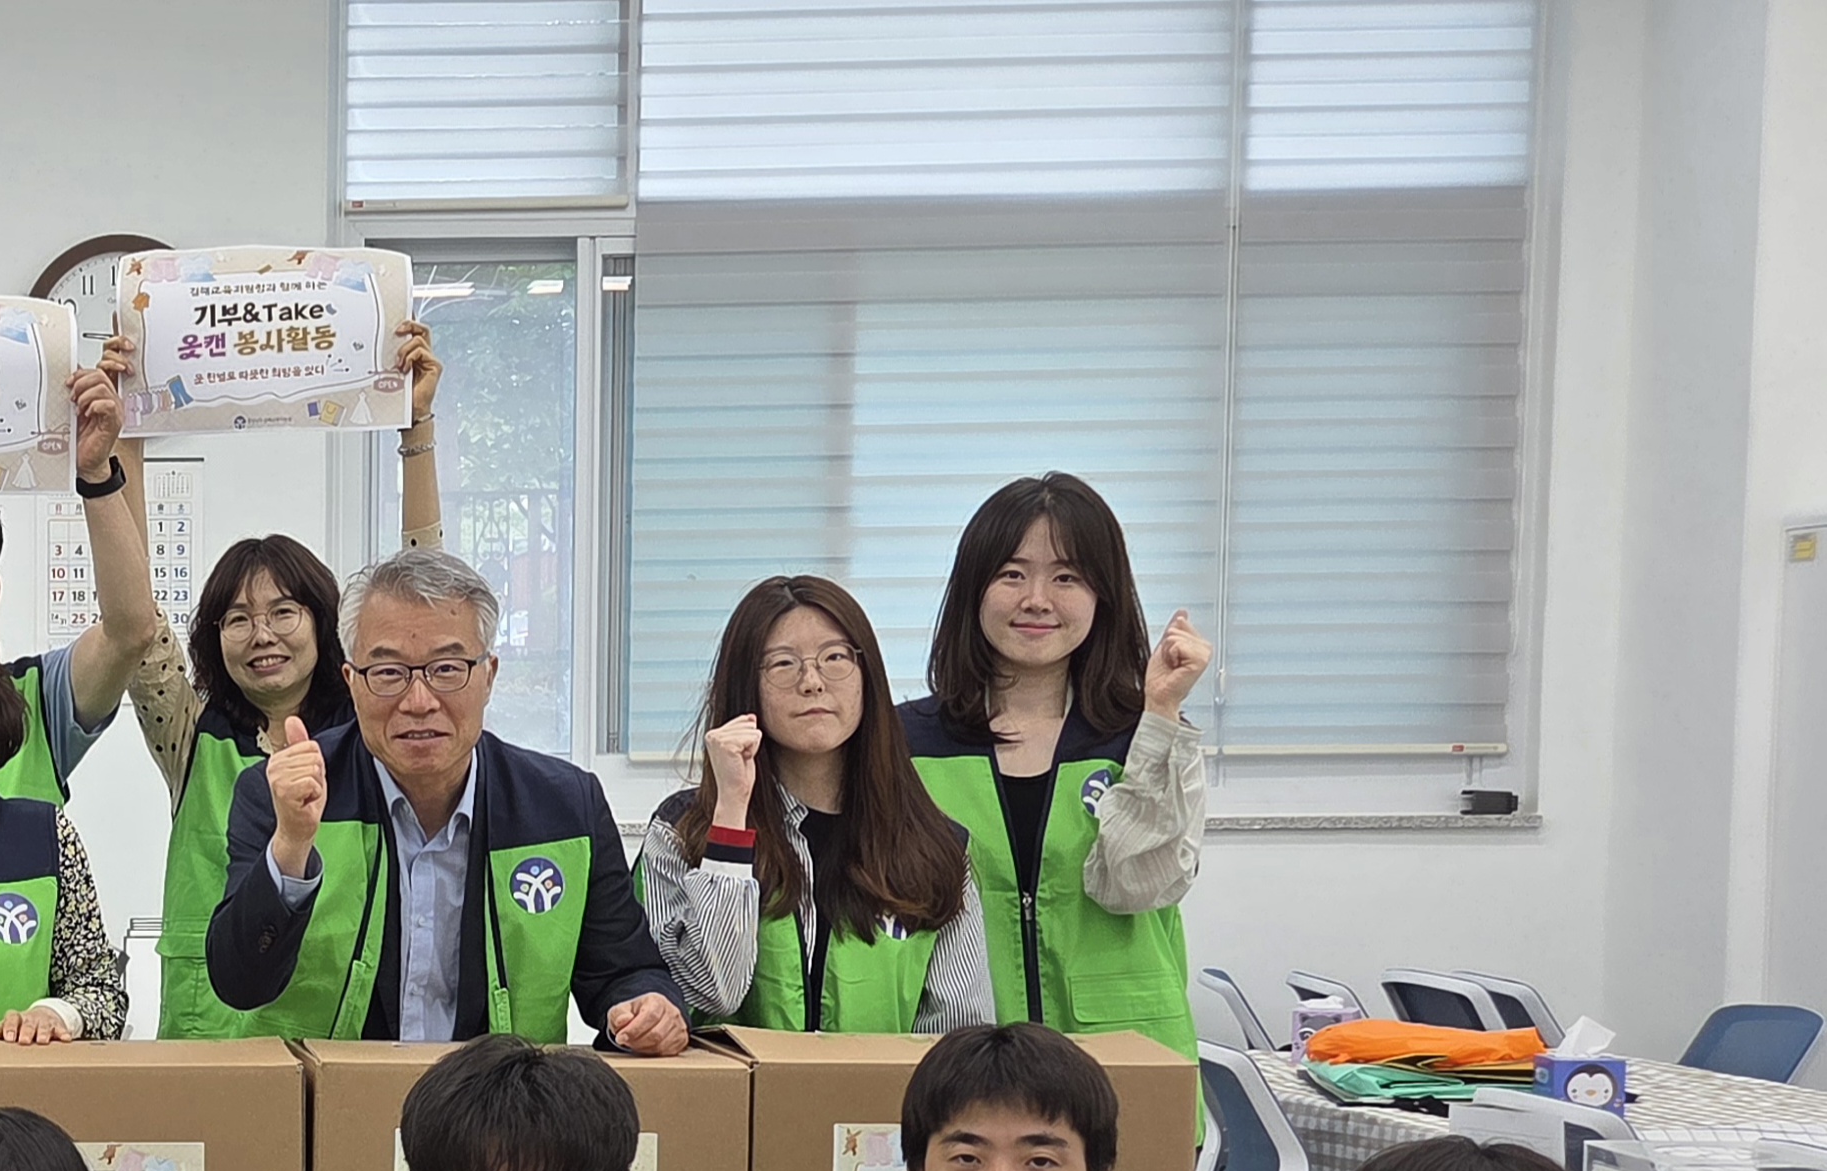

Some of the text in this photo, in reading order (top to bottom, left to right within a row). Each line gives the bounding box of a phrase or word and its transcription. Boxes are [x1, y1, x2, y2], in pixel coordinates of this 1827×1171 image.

[111, 265, 116, 286] 1
[82, 275, 94, 295] 11
[194, 302, 324, 328] 기부&Take
[178, 324, 336, 360] 옷캔 봉사활동
[158, 522, 185, 532] 1 2
[55, 545, 185, 555] 3 4 8 9
[51, 568, 188, 579] 10 11 15 16
[52, 590, 188, 601] 17 18 1 22 23
[72, 613, 86, 624] 25
[172, 613, 188, 623] 30
